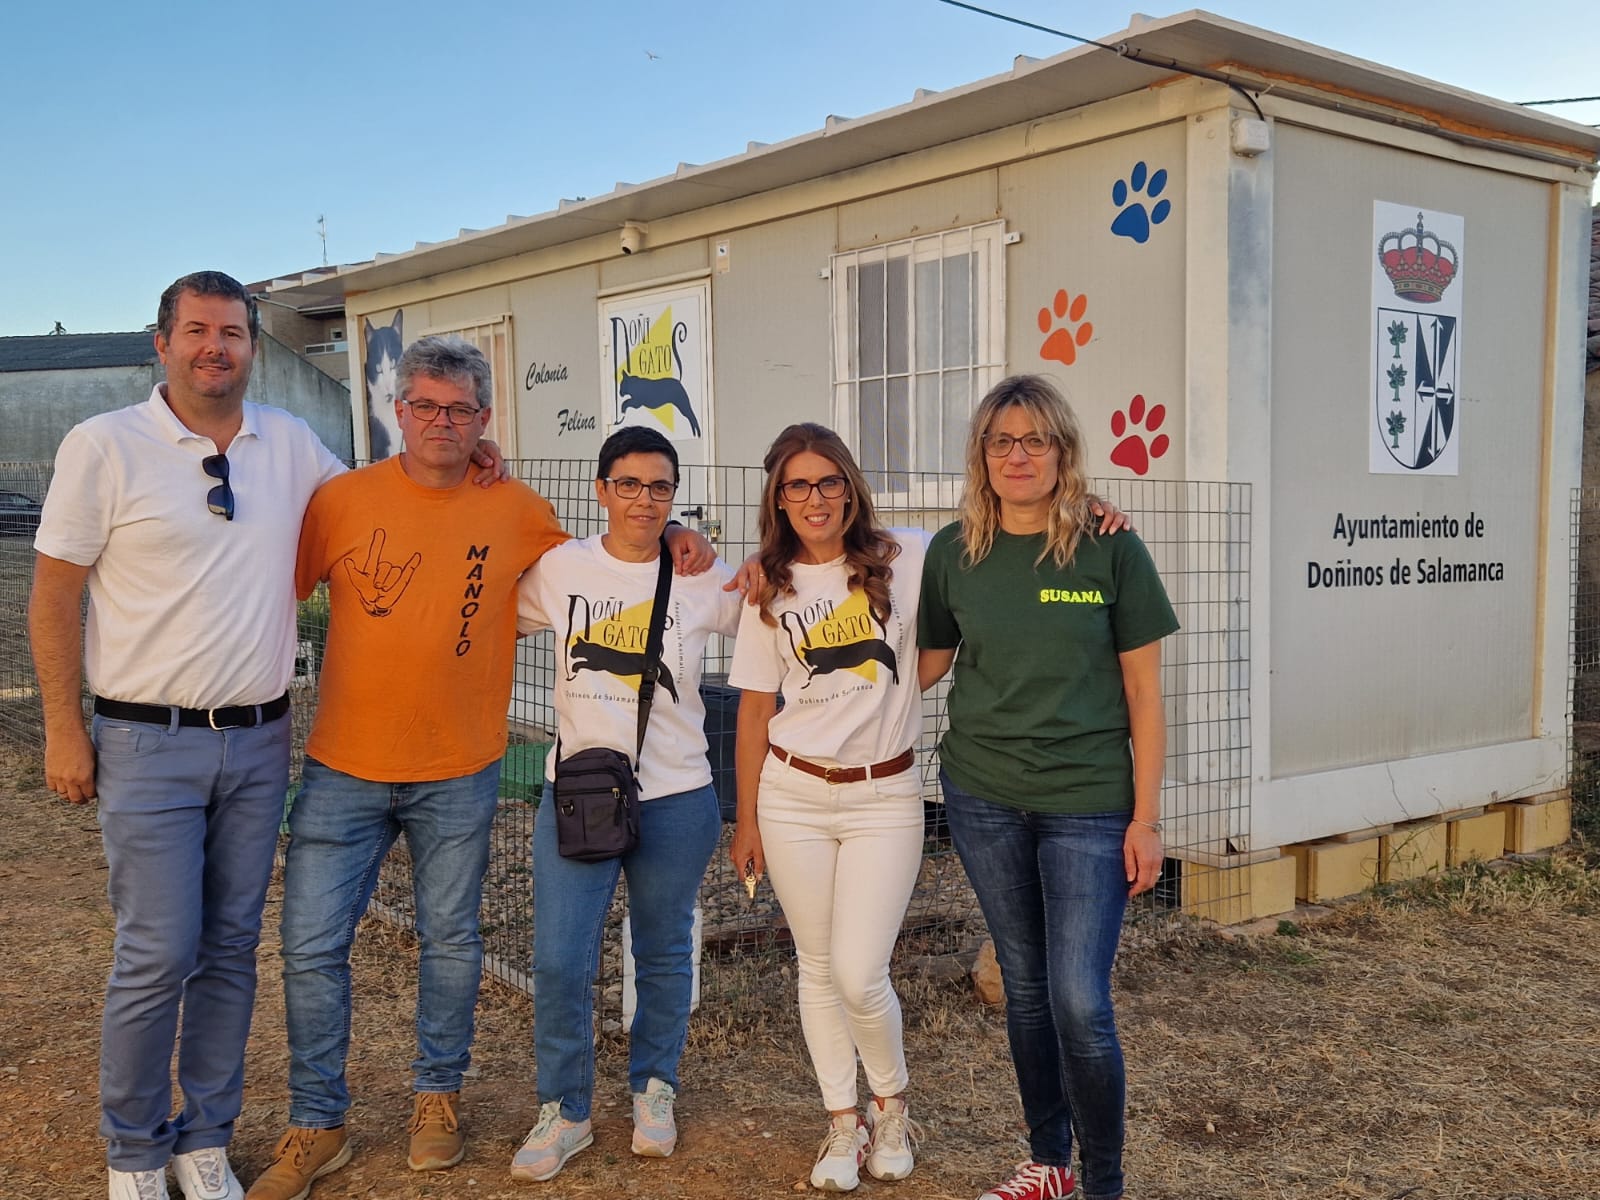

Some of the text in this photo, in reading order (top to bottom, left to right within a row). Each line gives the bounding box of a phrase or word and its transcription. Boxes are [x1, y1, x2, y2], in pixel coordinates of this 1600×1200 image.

[525, 362, 568, 391] Colonia
[557, 409, 596, 437] Felina
[1332, 512, 1484, 547] Ayuntamiento de
[1307, 557, 1504, 589] Doñinos de Salamanca
[455, 545, 490, 657] MANOLO
[1039, 588, 1105, 604] SUSANA
